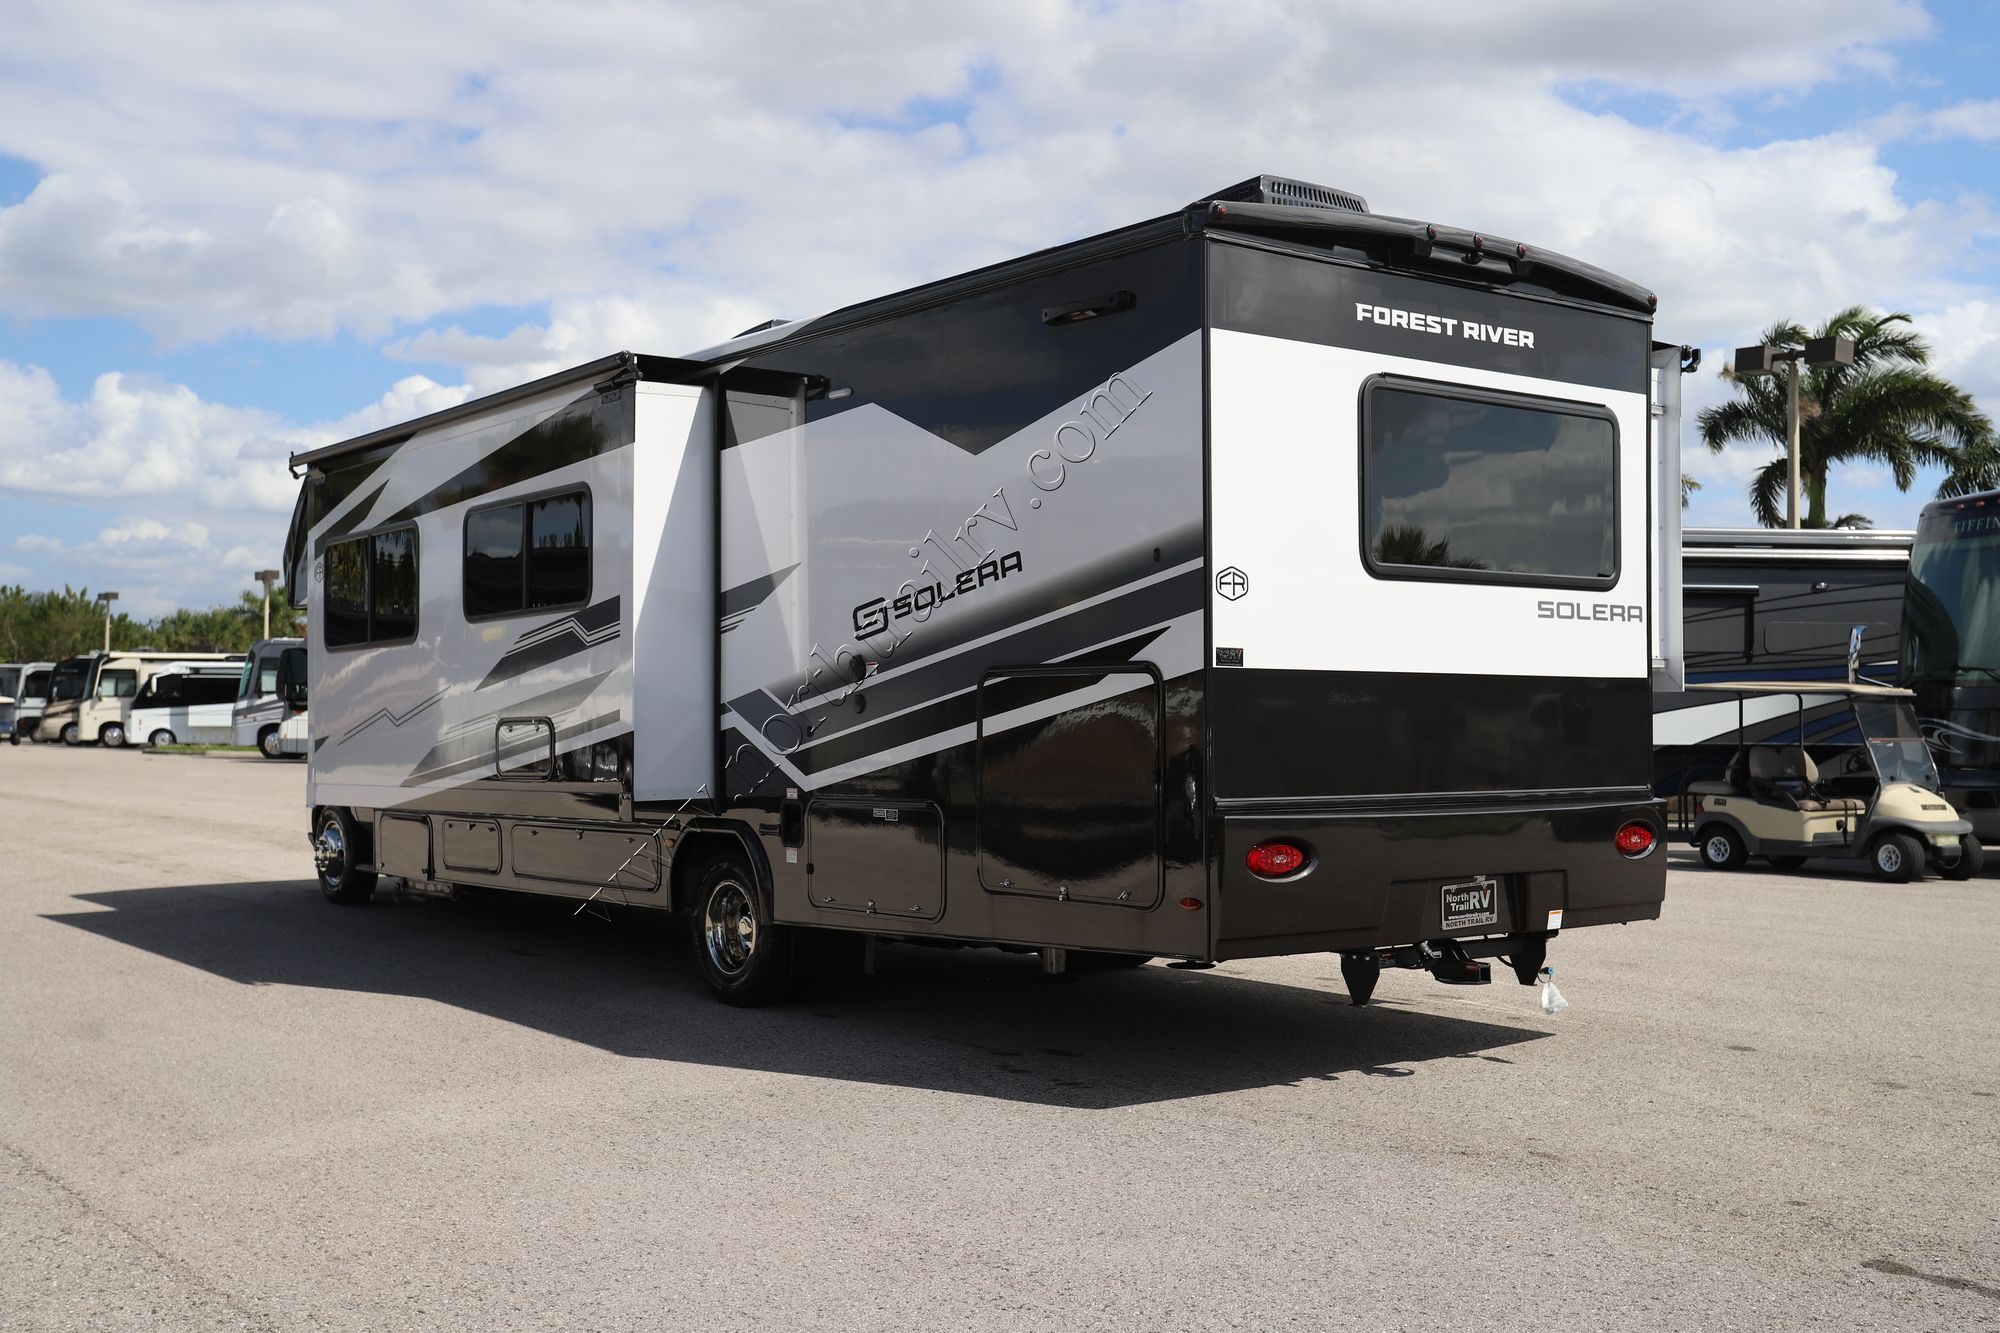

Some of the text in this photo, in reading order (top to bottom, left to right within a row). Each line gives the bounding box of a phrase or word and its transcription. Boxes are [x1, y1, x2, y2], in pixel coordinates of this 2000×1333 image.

[1355, 302, 1535, 349] FOREST RIVER
[893, 550, 1023, 620] SOLERA
[1537, 600, 1643, 623] SOLERA
[1446, 892, 1469, 903] North
[1450, 901, 1469, 912] Trail
[1470, 889, 1491, 910] RV
[1445, 919, 1466, 928] NORTH
[1468, 918, 1484, 926] TRAIL
